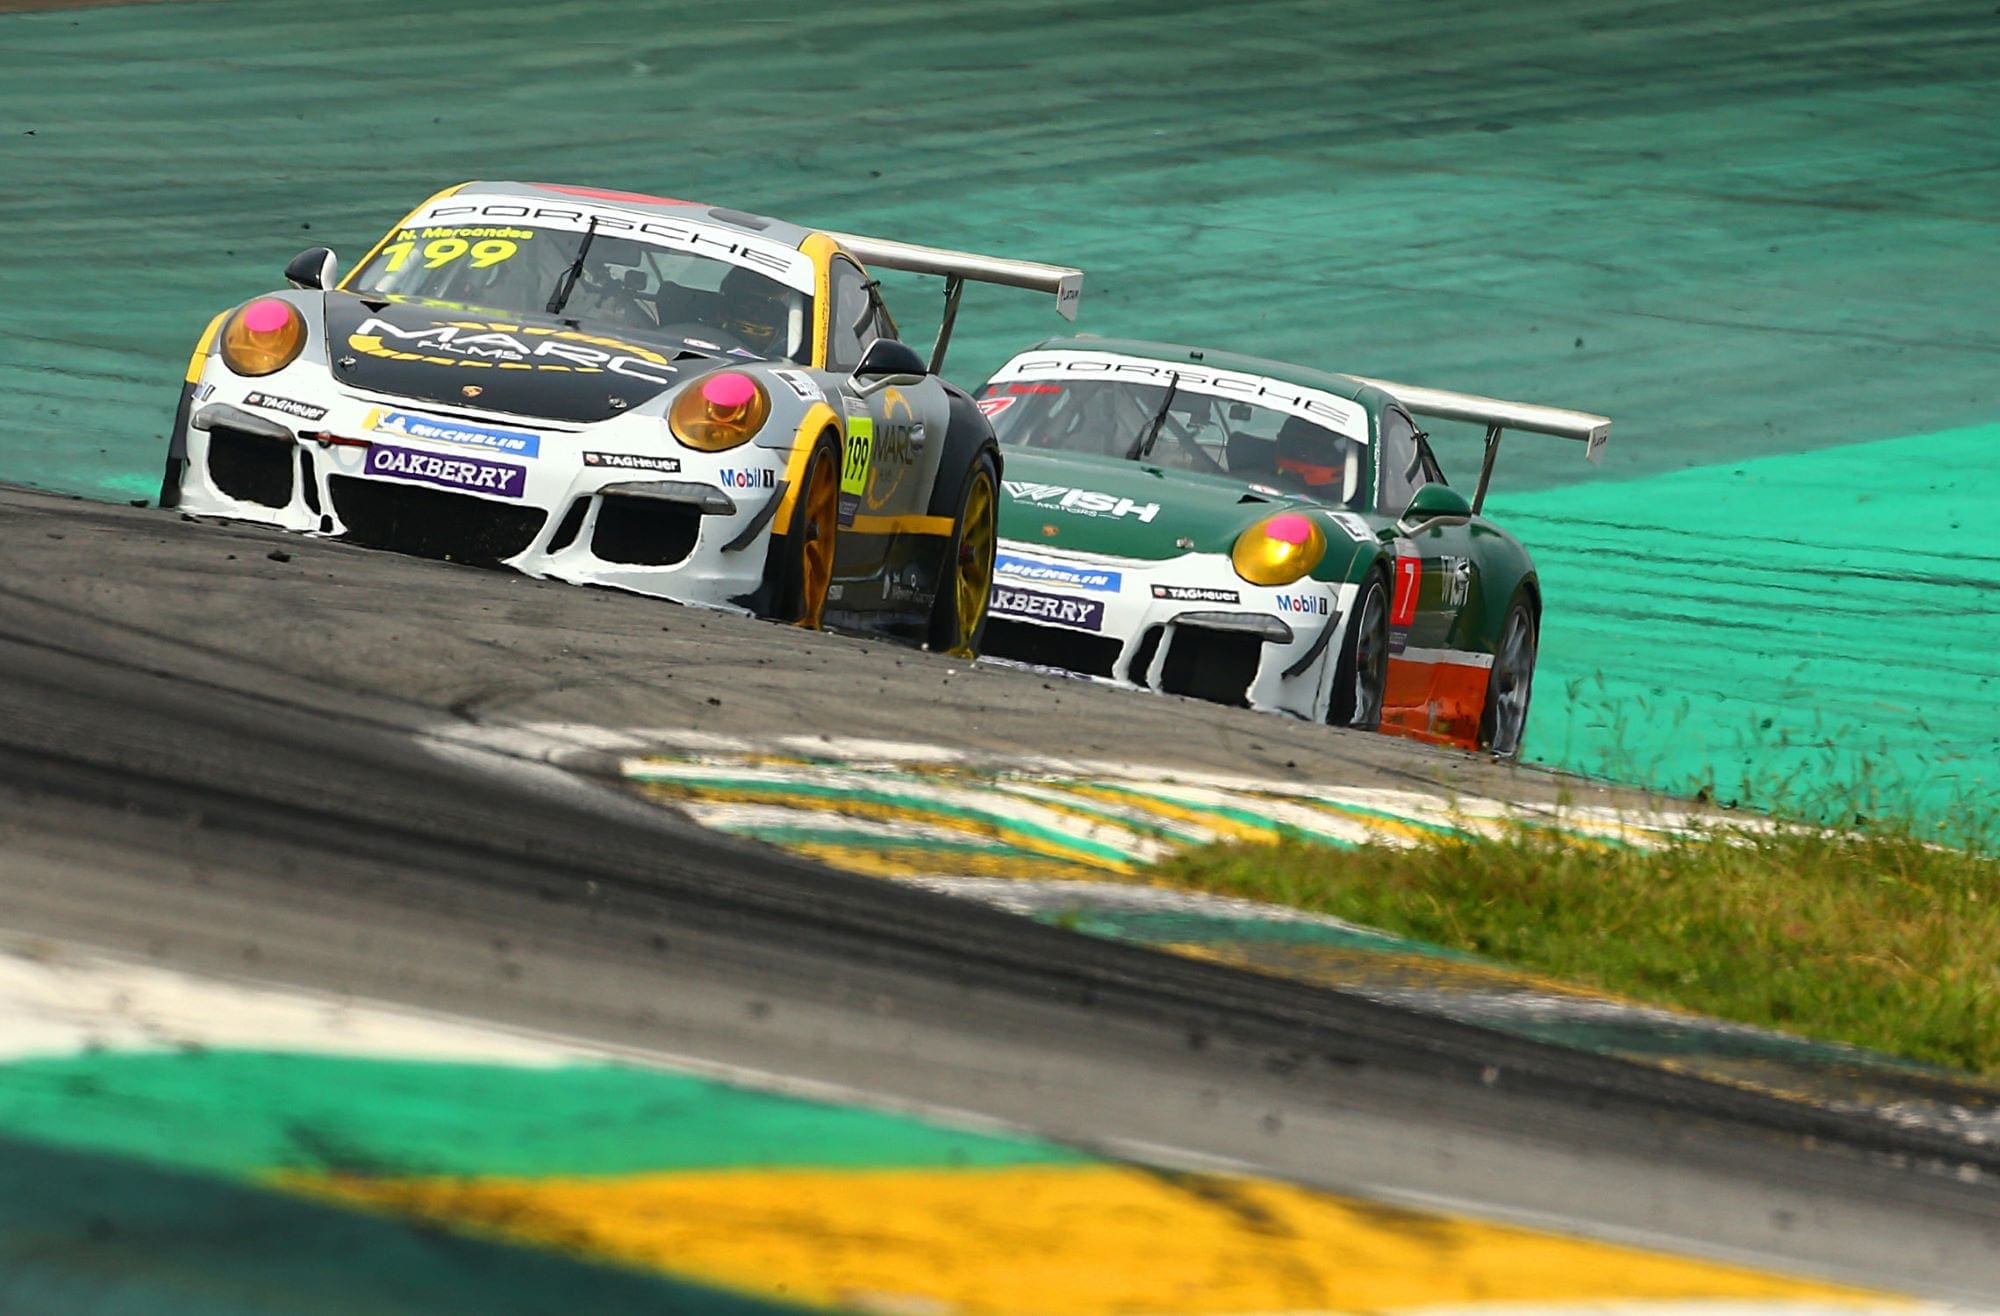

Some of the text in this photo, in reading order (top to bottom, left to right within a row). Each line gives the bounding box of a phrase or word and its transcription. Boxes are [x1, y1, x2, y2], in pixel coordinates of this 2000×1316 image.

[381, 237, 519, 273] 199
[429, 204, 794, 275] PORSCHE
[355, 317, 678, 385] MARC
[416, 339, 524, 361] FILMS
[1017, 360, 1350, 426] PORSCHE
[410, 423, 527, 451] MICHELIN
[373, 450, 517, 490] OAKBERRY
[719, 467, 761, 488] Mobil
[844, 436, 869, 481] 199
[1000, 480, 1161, 523] WISH
[1036, 501, 1098, 518] MOTORS
[1001, 562, 1109, 586] MICHELIN
[1399, 563, 1415, 619] 7
[1276, 595, 1317, 614] Mobil
